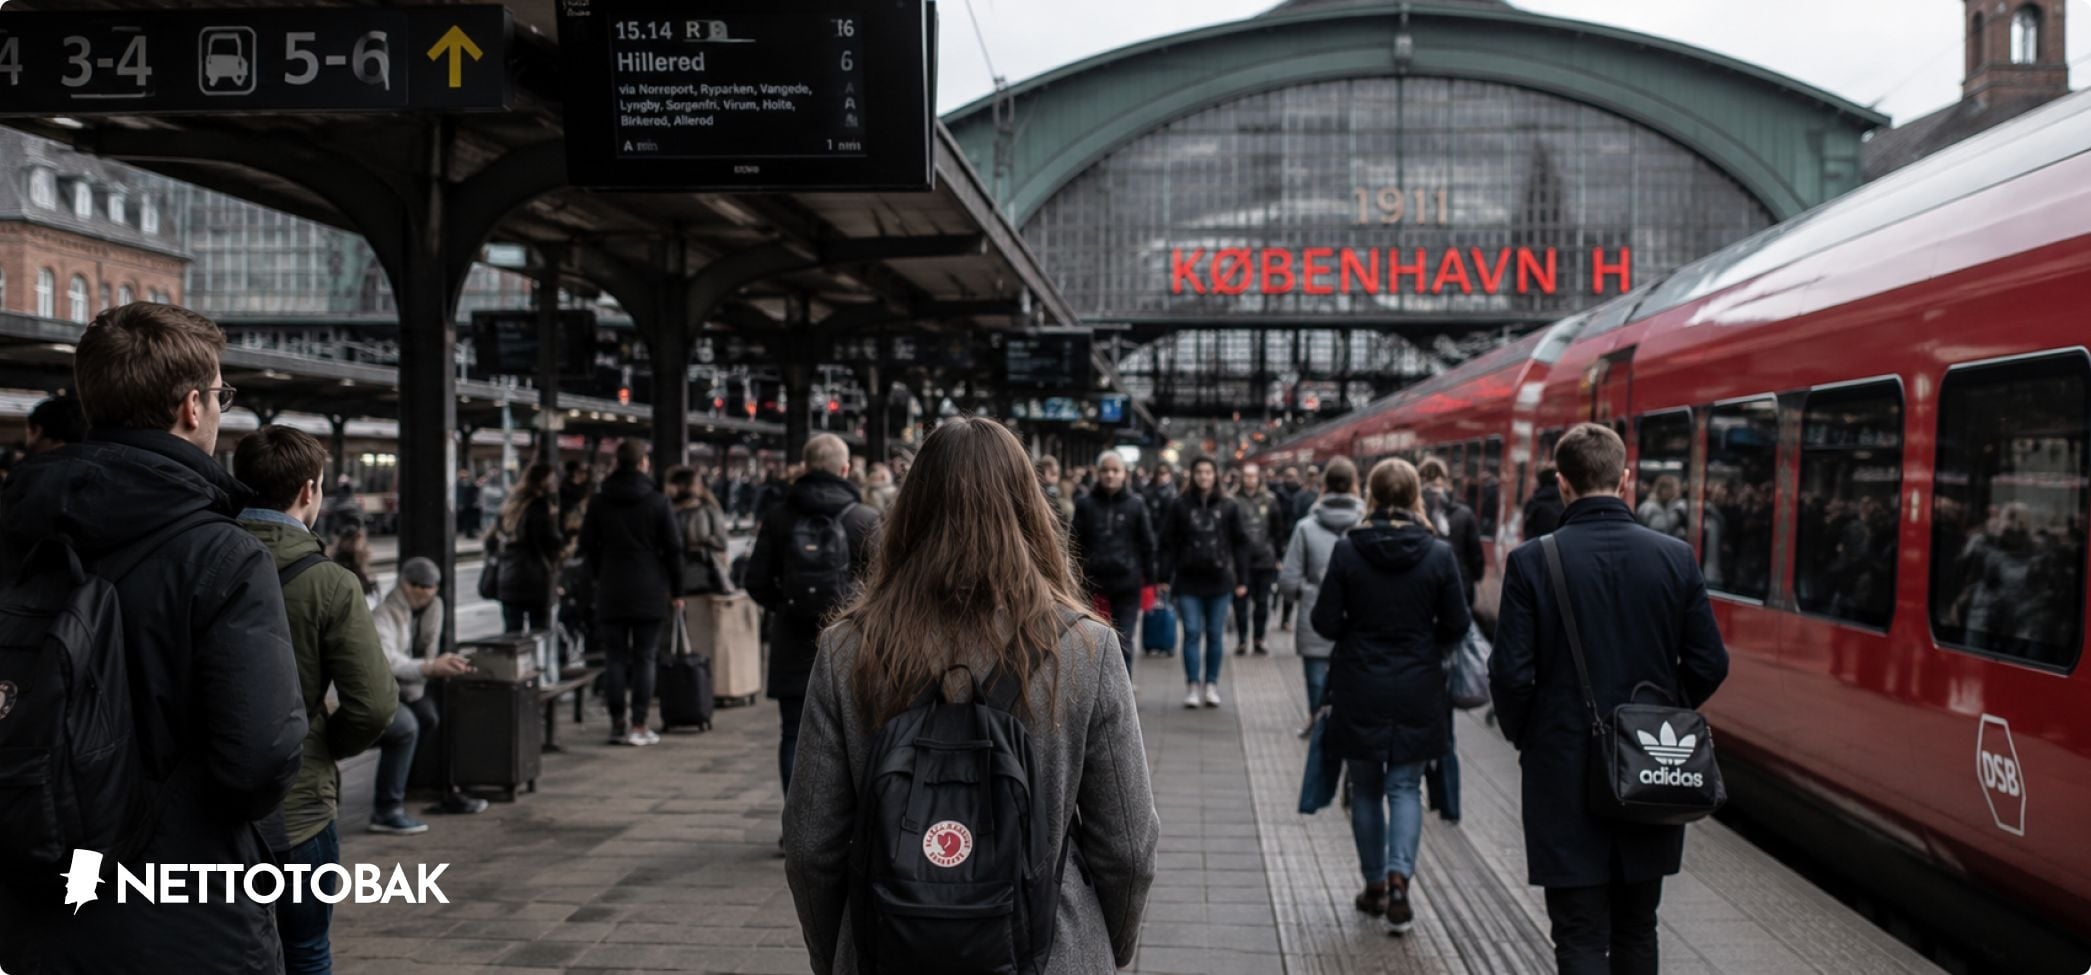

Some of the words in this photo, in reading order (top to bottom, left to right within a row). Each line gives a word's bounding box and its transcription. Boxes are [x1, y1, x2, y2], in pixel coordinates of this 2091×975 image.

[615, 20, 673, 40] 15.14
[685, 20, 701, 39] R
[61, 35, 153, 87] 3-4
[284, 31, 390, 91] 5-6
[617, 51, 705, 72] Hillered
[840, 50, 854, 72] 6
[618, 83, 636, 95] via
[700, 83, 758, 97] Ryparken,
[760, 82, 813, 97] Vangede,
[723, 99, 761, 112] Virum,
[762, 99, 797, 112] Holte,
[1353, 187, 1447, 225] 1911
[1171, 247, 1557, 294] KØBENHAVN
[1592, 246, 1632, 294] H
[1639, 766, 1704, 788] adidas
[1982, 750, 2020, 797] DSB
